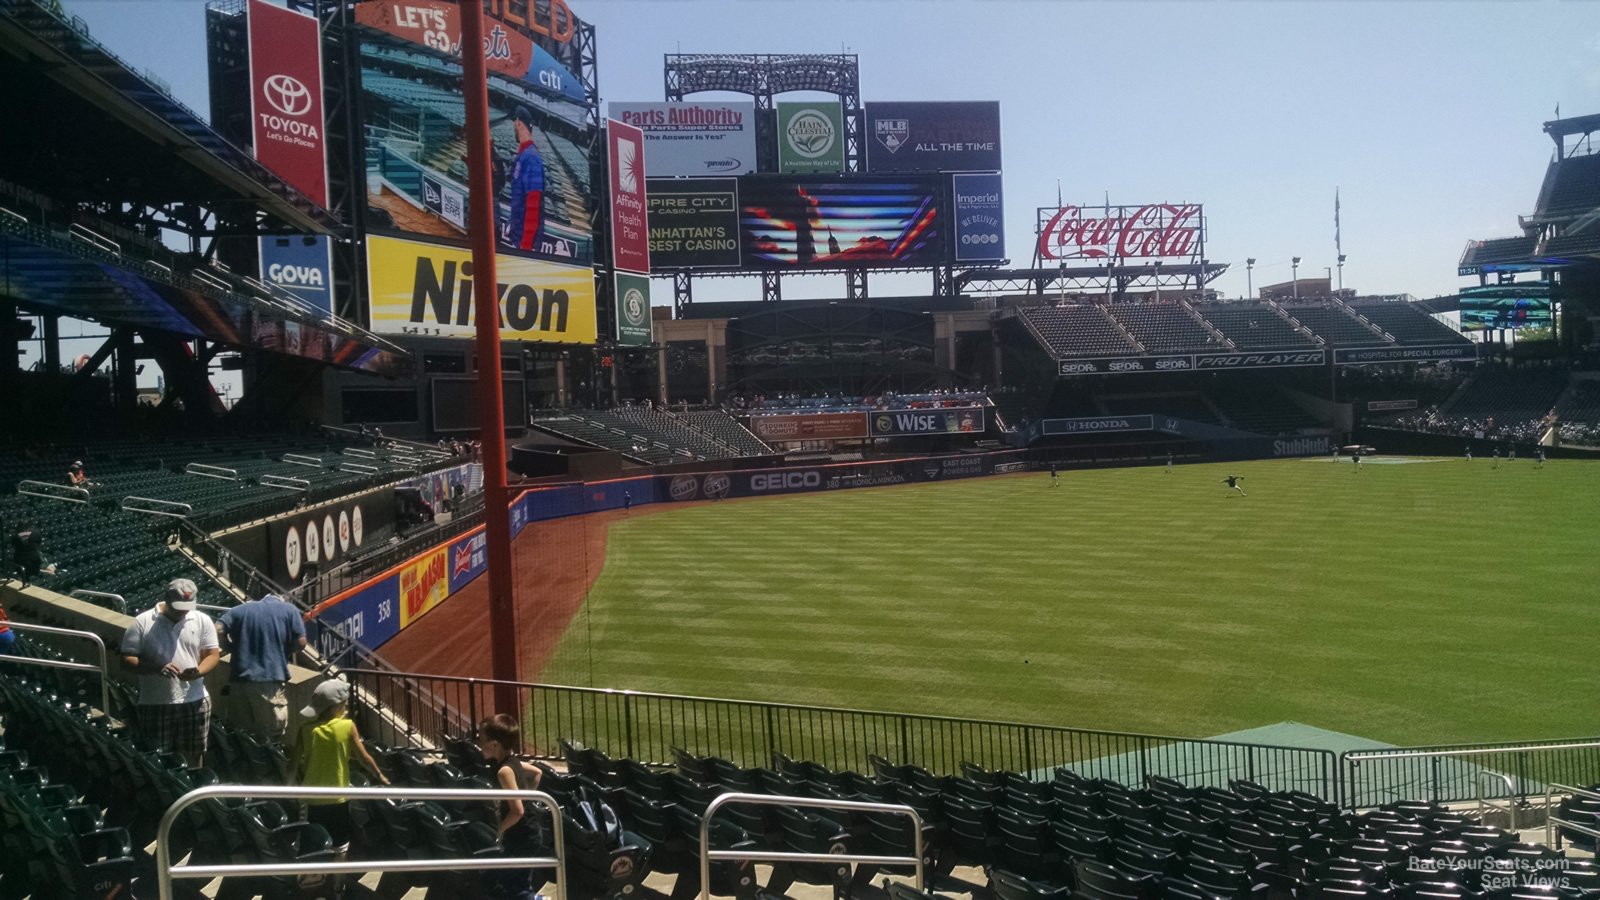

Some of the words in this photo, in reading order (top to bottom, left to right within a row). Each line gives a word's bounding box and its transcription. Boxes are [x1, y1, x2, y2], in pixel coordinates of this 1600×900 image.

[393, 4, 447, 31] LET'S
[423, 30, 450, 52] GO
[538, 69, 562, 91] citi
[622, 109, 665, 126] Parts
[668, 105, 743, 127] Authority
[260, 113, 319, 140] TOYOTA
[678, 124, 707, 132] Super
[788, 127, 834, 137] CELESTIAL
[799, 121, 822, 129] HAIN
[877, 121, 907, 131] MLB
[266, 130, 283, 141] Let's
[283, 135, 293, 143] Go
[915, 142, 938, 152] ALL
[940, 142, 963, 151] THE
[965, 142, 994, 151] TIME
[616, 193, 643, 213] Affinity
[691, 198, 728, 207] CITY
[957, 192, 999, 205] Imperial
[618, 211, 642, 227] Health
[961, 216, 973, 228] WE
[972, 214, 999, 228] DELIVER
[623, 225, 639, 240] Plan
[648, 240, 682, 252] SEST
[685, 239, 736, 251] CASINO
[268, 263, 324, 286] GOYA
[1459, 267, 1476, 275] 11:34
[409, 256, 570, 333] Nion
[1197, 354, 1239, 367] PRO
[1243, 353, 1323, 365] PLAYER
[1358, 351, 1388, 360] HOSPITAL
[1432, 348, 1463, 356] SURGERY
[896, 413, 937, 432] WISE
[1078, 419, 1130, 430] HONDA
[1273, 436, 1329, 456] StubHub!
[942, 458, 959, 467] EAST
[960, 457, 981, 466] COAST
[750, 470, 821, 491] GEICO
[826, 480, 840, 489] 380
[852, 476, 877, 487] KONICA
[877, 474, 905, 486] MINOLTA
[325, 526, 333, 547] 41
[341, 520, 348, 541] 42
[308, 532, 316, 555] 14
[288, 540, 297, 565] 37
[377, 599, 391, 624] 358
